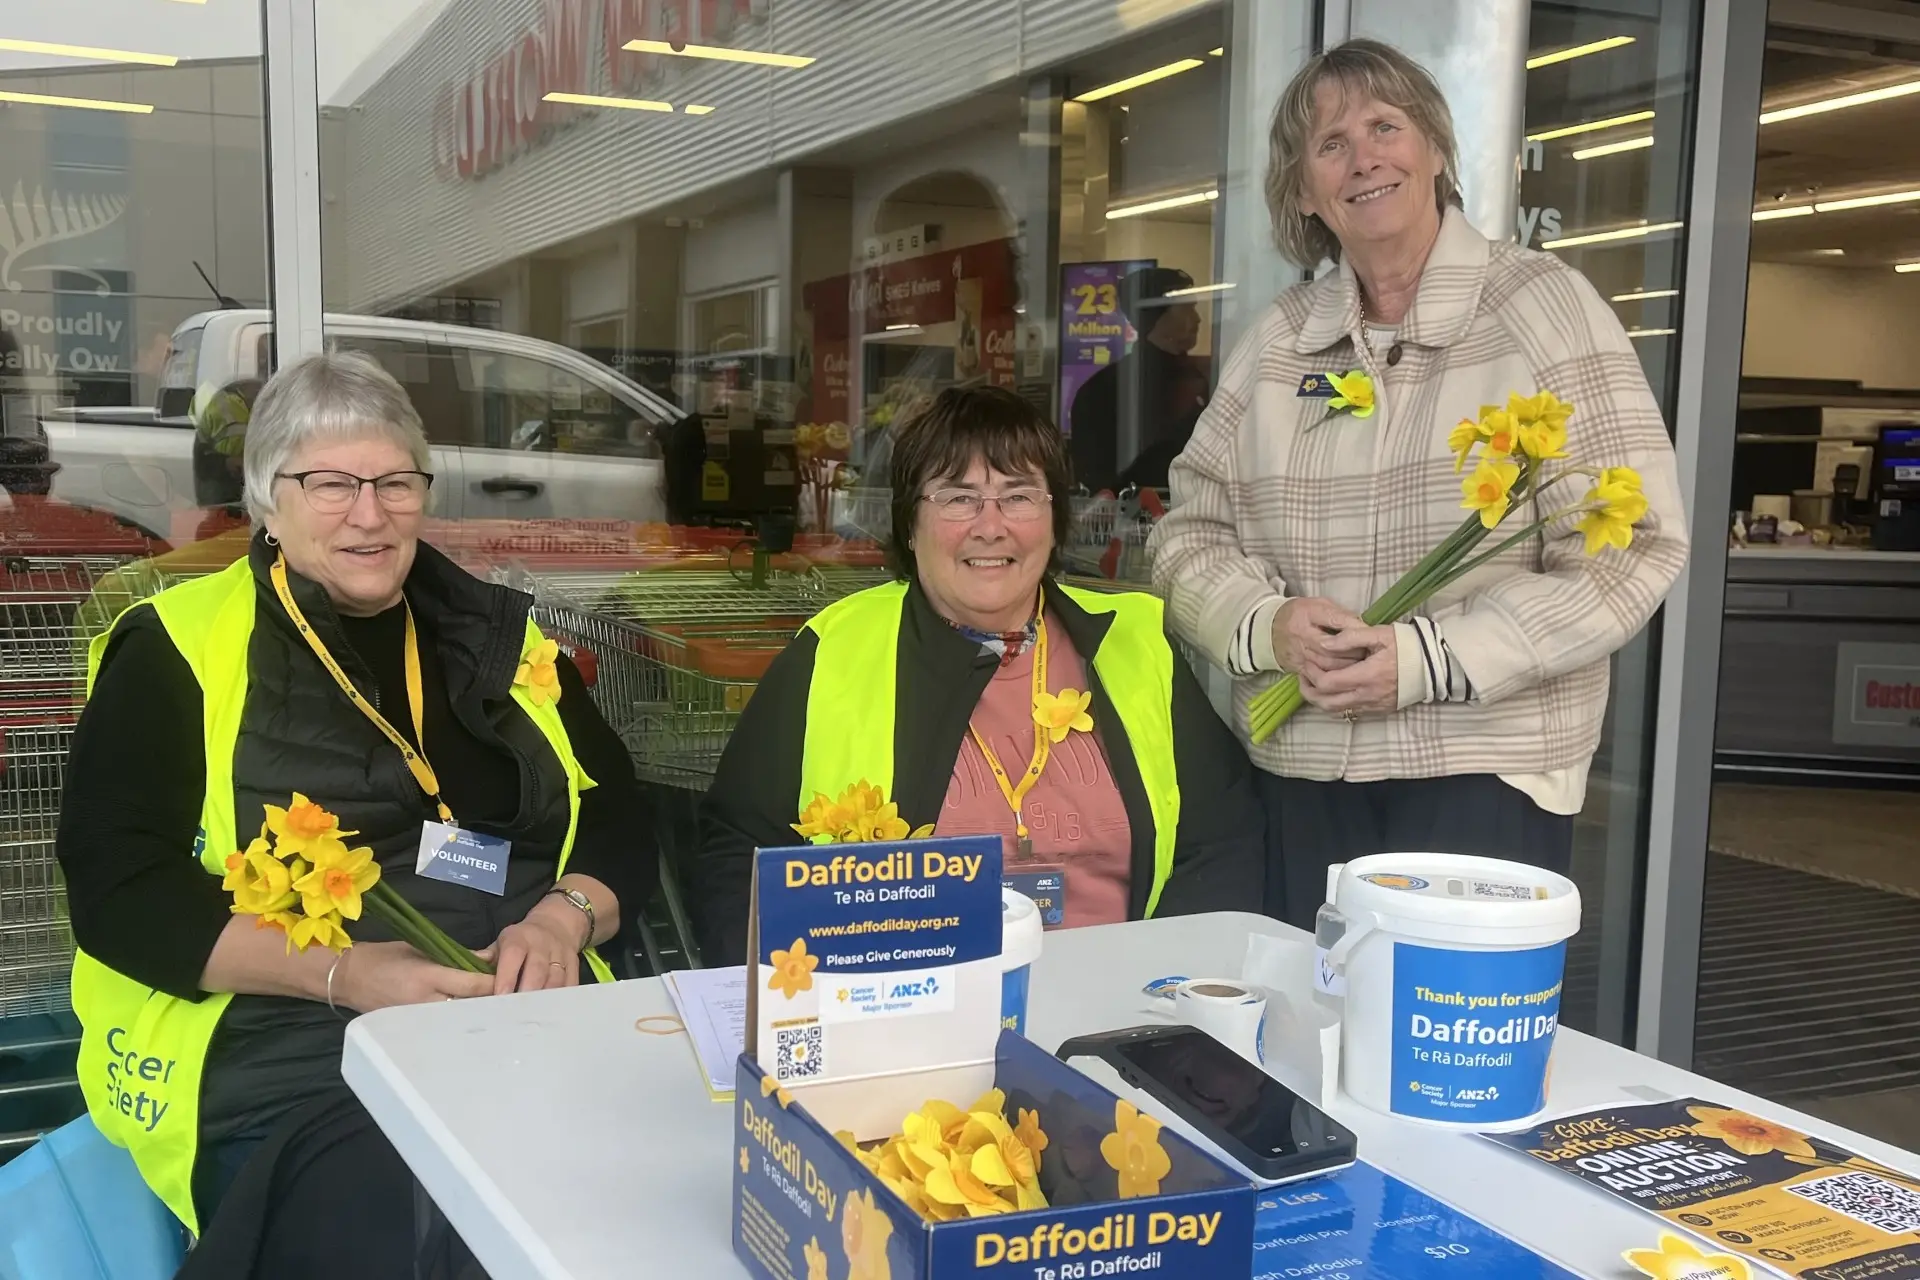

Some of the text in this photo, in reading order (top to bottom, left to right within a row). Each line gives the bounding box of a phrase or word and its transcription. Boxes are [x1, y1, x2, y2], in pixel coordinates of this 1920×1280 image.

[0, 308, 123, 343] Proudly
[1068, 322, 1122, 338] Million
[431, 848, 499, 874] VOLUNTEER
[785, 852, 983, 889] Daffodil Day
[834, 891, 850, 905] Te
[879, 885, 935, 901] Daffodil
[809, 916, 960, 938] www.daffodilday.org.nz
[826, 945, 957, 967] Please Give Generously
[889, 983, 922, 998] ANZ
[1415, 986, 1466, 1006] Thank
[1468, 995, 1498, 1010] you
[1501, 992, 1522, 1007] for
[1410, 1010, 1559, 1045] Daffodil Day
[1411, 1047, 1429, 1062] Te
[1454, 1053, 1512, 1068] Daffodil
[1421, 1084, 1485, 1101] Cancer ANZ
[1554, 1116, 1617, 1139] GORE
[1527, 1124, 1701, 1162] Daffodil Day
[743, 1099, 801, 1181] Daffodil
[805, 1159, 838, 1223] Day
[1575, 1141, 1693, 1173] ONLINE
[1598, 1151, 1748, 1191] AUCTION
[782, 1177, 812, 1218] Daffodil
[1278, 1191, 1329, 1206] List
[1374, 1213, 1440, 1229] Donation
[975, 1211, 1223, 1268] Daffodil Day
[1252, 1229, 1349, 1251] Daffodil Pin
[1424, 1243, 1470, 1261] $10
[1034, 1267, 1056, 1280] Te
[1091, 1252, 1162, 1278] Daffodil
[1284, 1257, 1363, 1277] Daffodils
